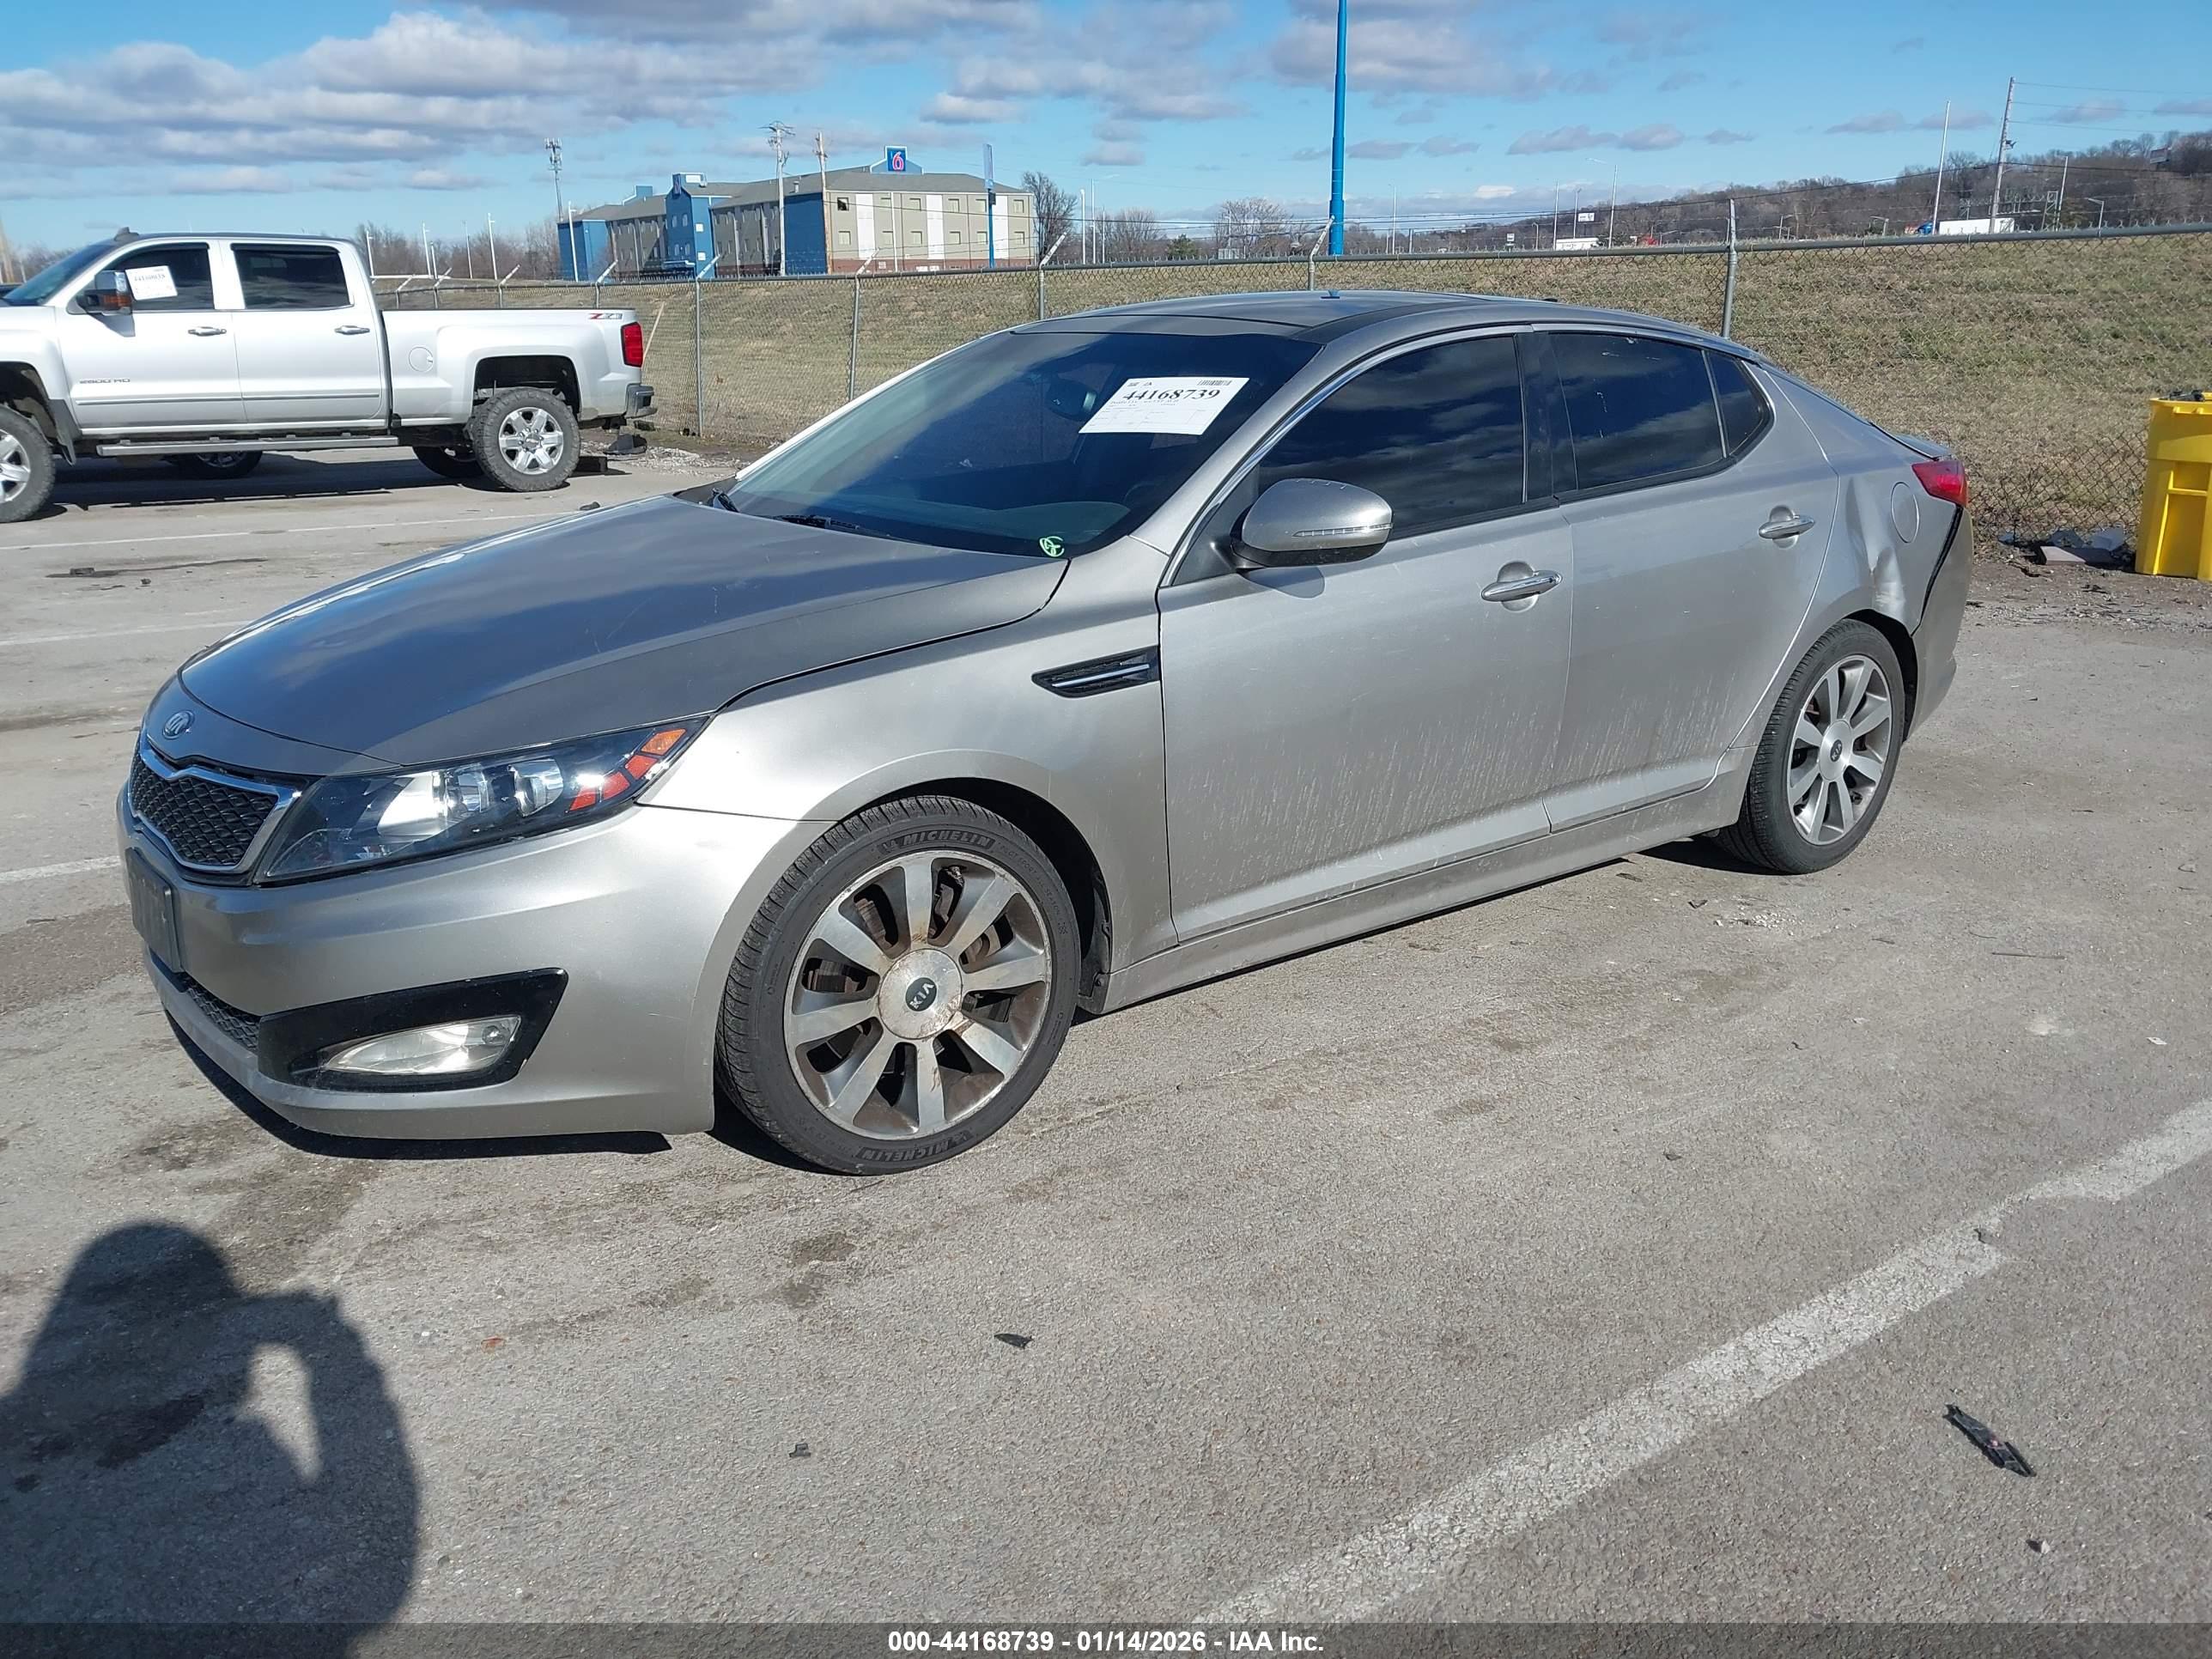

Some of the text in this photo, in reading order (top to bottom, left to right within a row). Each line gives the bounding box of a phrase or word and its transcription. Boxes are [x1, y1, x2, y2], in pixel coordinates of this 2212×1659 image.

[892, 151, 904, 171] 6
[1123, 389, 1220, 399] 44168739
[902, 830, 991, 847] MICHELIN
[909, 982, 935, 1010] KIA
